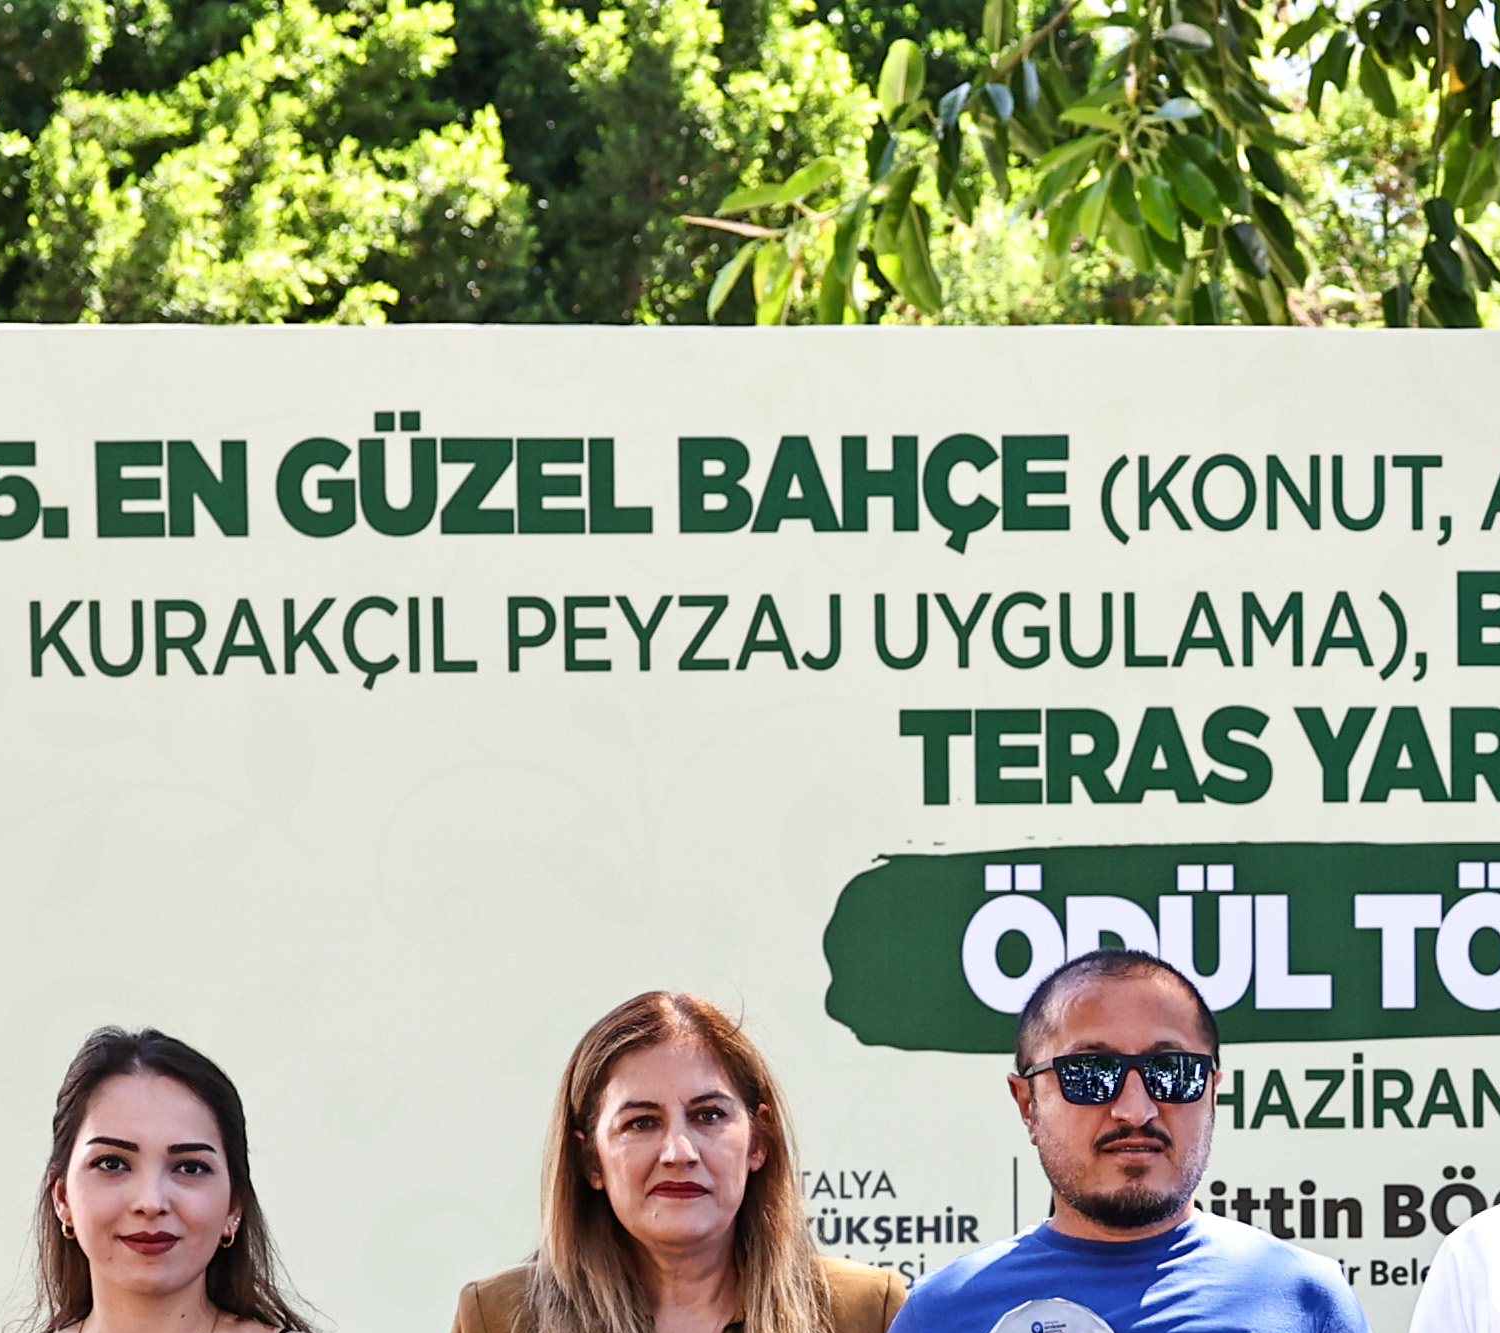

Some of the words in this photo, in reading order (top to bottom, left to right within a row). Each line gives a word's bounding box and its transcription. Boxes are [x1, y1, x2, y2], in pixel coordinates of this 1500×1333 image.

[95, 440, 249, 538] EN
[276, 411, 653, 538] GÜZEL
[678, 433, 1070, 554] BAHÇE
[1101, 454, 1451, 546] (KONUT,
[30, 596, 477, 690] KURAKÇIL
[508, 594, 841, 672] PEYZAJ
[874, 591, 1427, 682] UYGULAMA),
[899, 706, 1273, 805] TERAS
